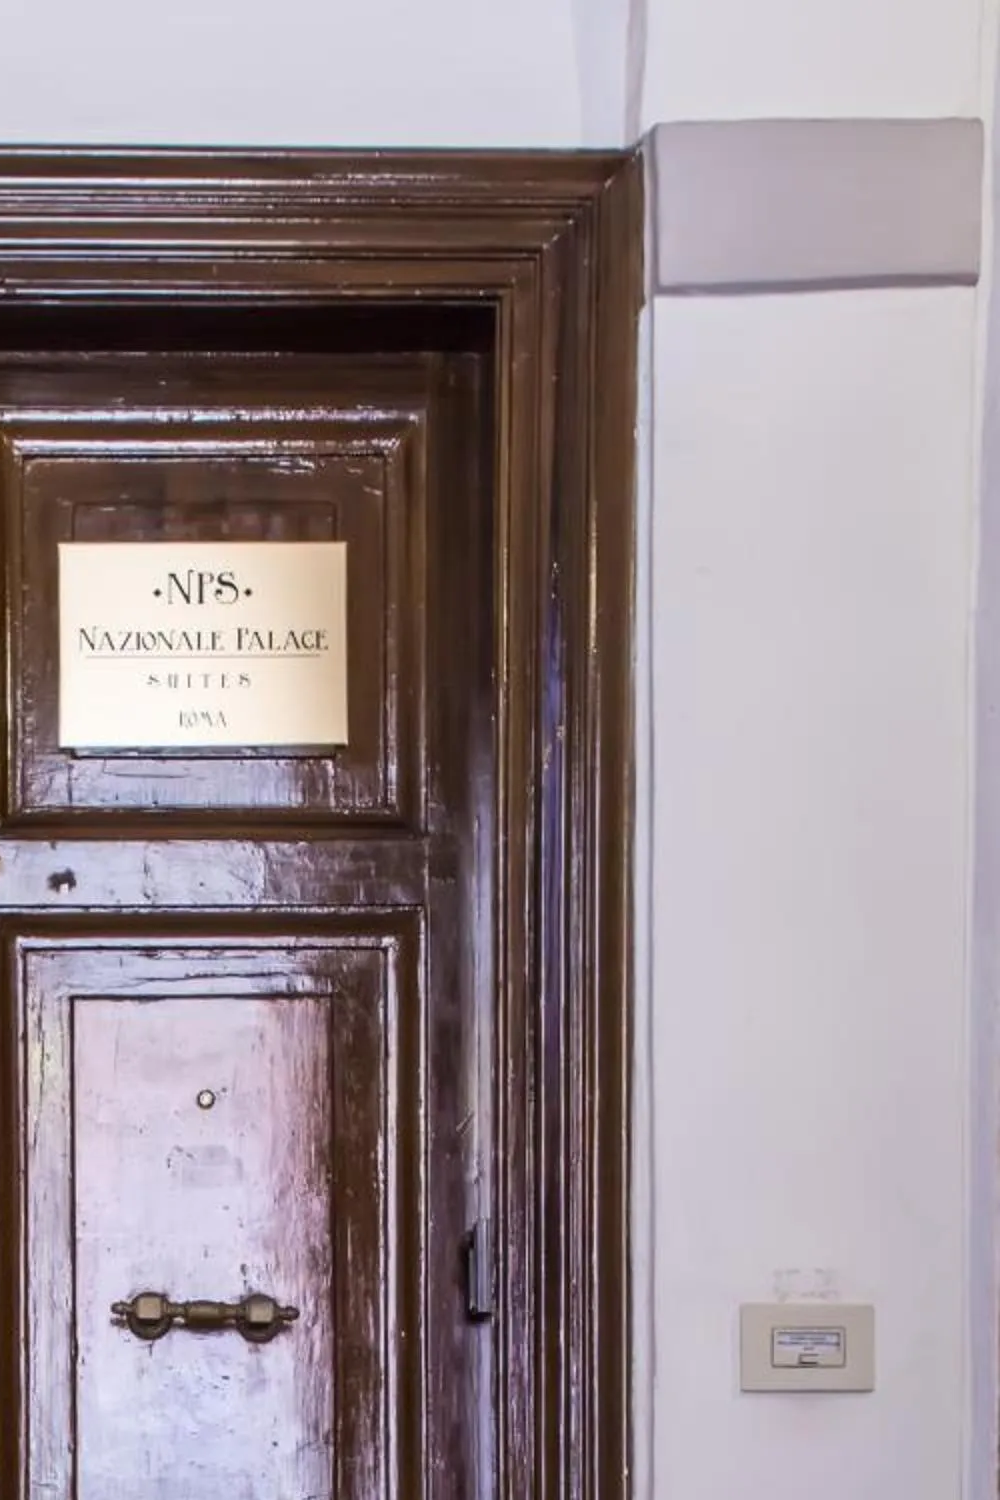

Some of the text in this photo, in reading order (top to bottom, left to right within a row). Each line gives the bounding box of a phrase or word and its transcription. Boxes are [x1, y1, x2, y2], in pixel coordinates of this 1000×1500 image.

[79, 625, 329, 651] NAZIONALE PALACE
[147, 672, 252, 689] SUITES
[178, 709, 228, 729] ROMA
